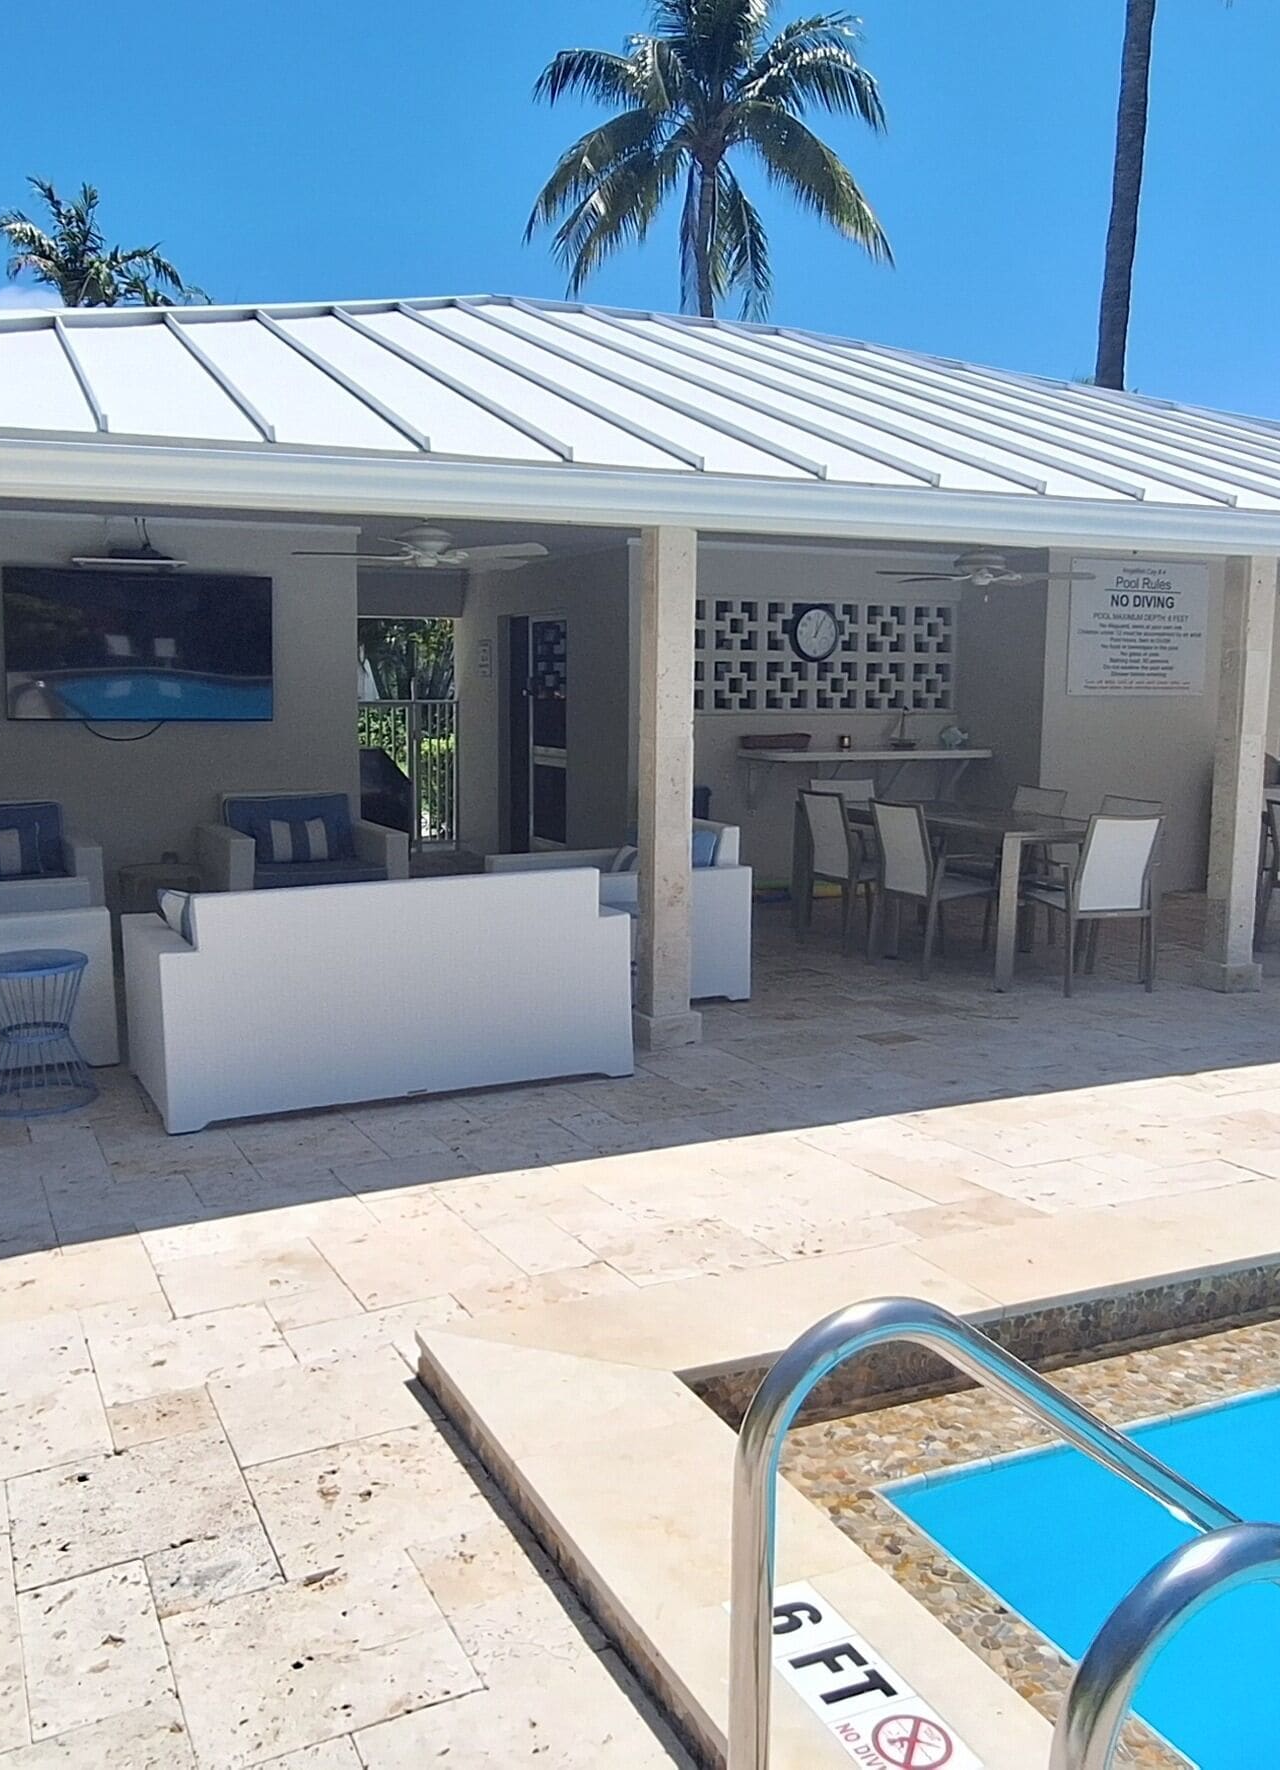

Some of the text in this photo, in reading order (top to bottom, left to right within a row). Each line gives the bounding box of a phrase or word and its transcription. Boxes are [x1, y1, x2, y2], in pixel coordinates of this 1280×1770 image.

[1115, 576, 1172, 590] Pool Rules
[1110, 594, 1175, 609] NO DIVING
[772, 1602, 898, 1705] 6 FT
[835, 1722, 861, 1743] NO
